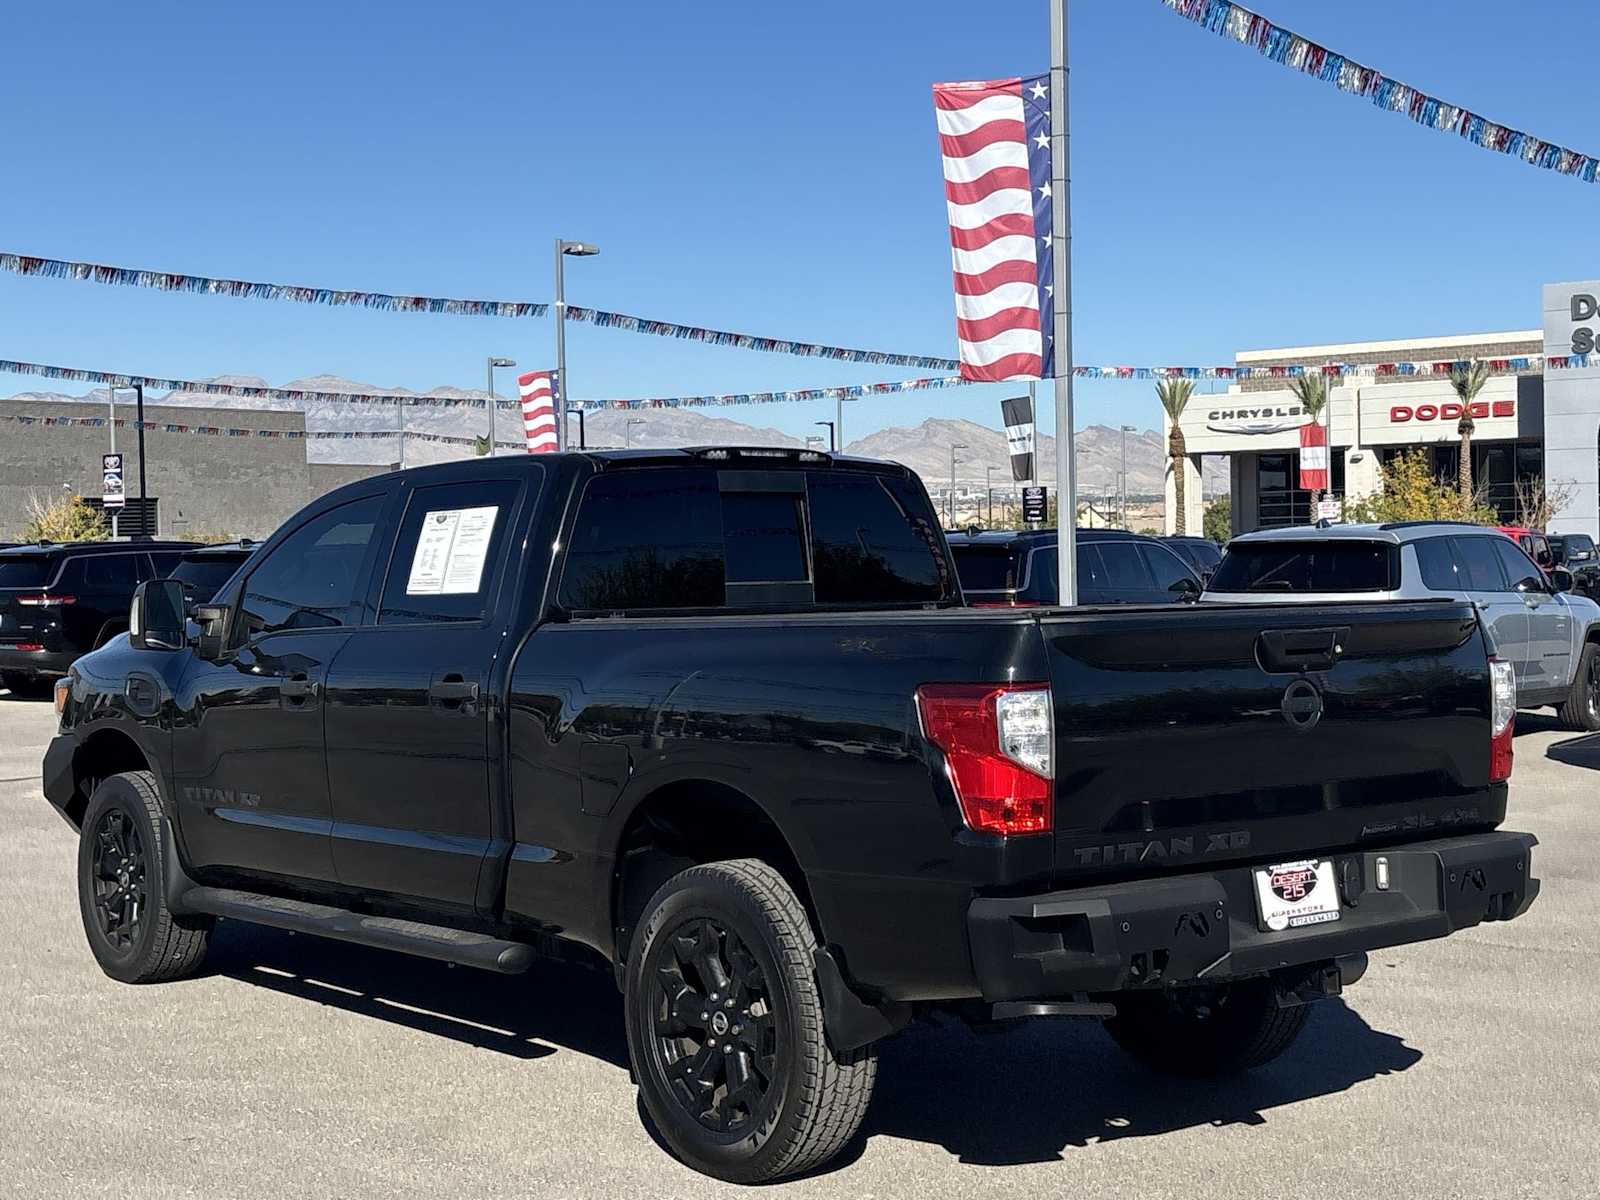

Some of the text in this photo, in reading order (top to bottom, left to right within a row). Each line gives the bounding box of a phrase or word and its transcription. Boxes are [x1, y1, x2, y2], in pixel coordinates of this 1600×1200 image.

[1571, 294, 1600, 321] D
[1390, 400, 1515, 422] DODGE
[1073, 831, 1251, 865] TITAN XD
[1273, 870, 1313, 885] DESERT
[1283, 884, 1306, 899] 215
